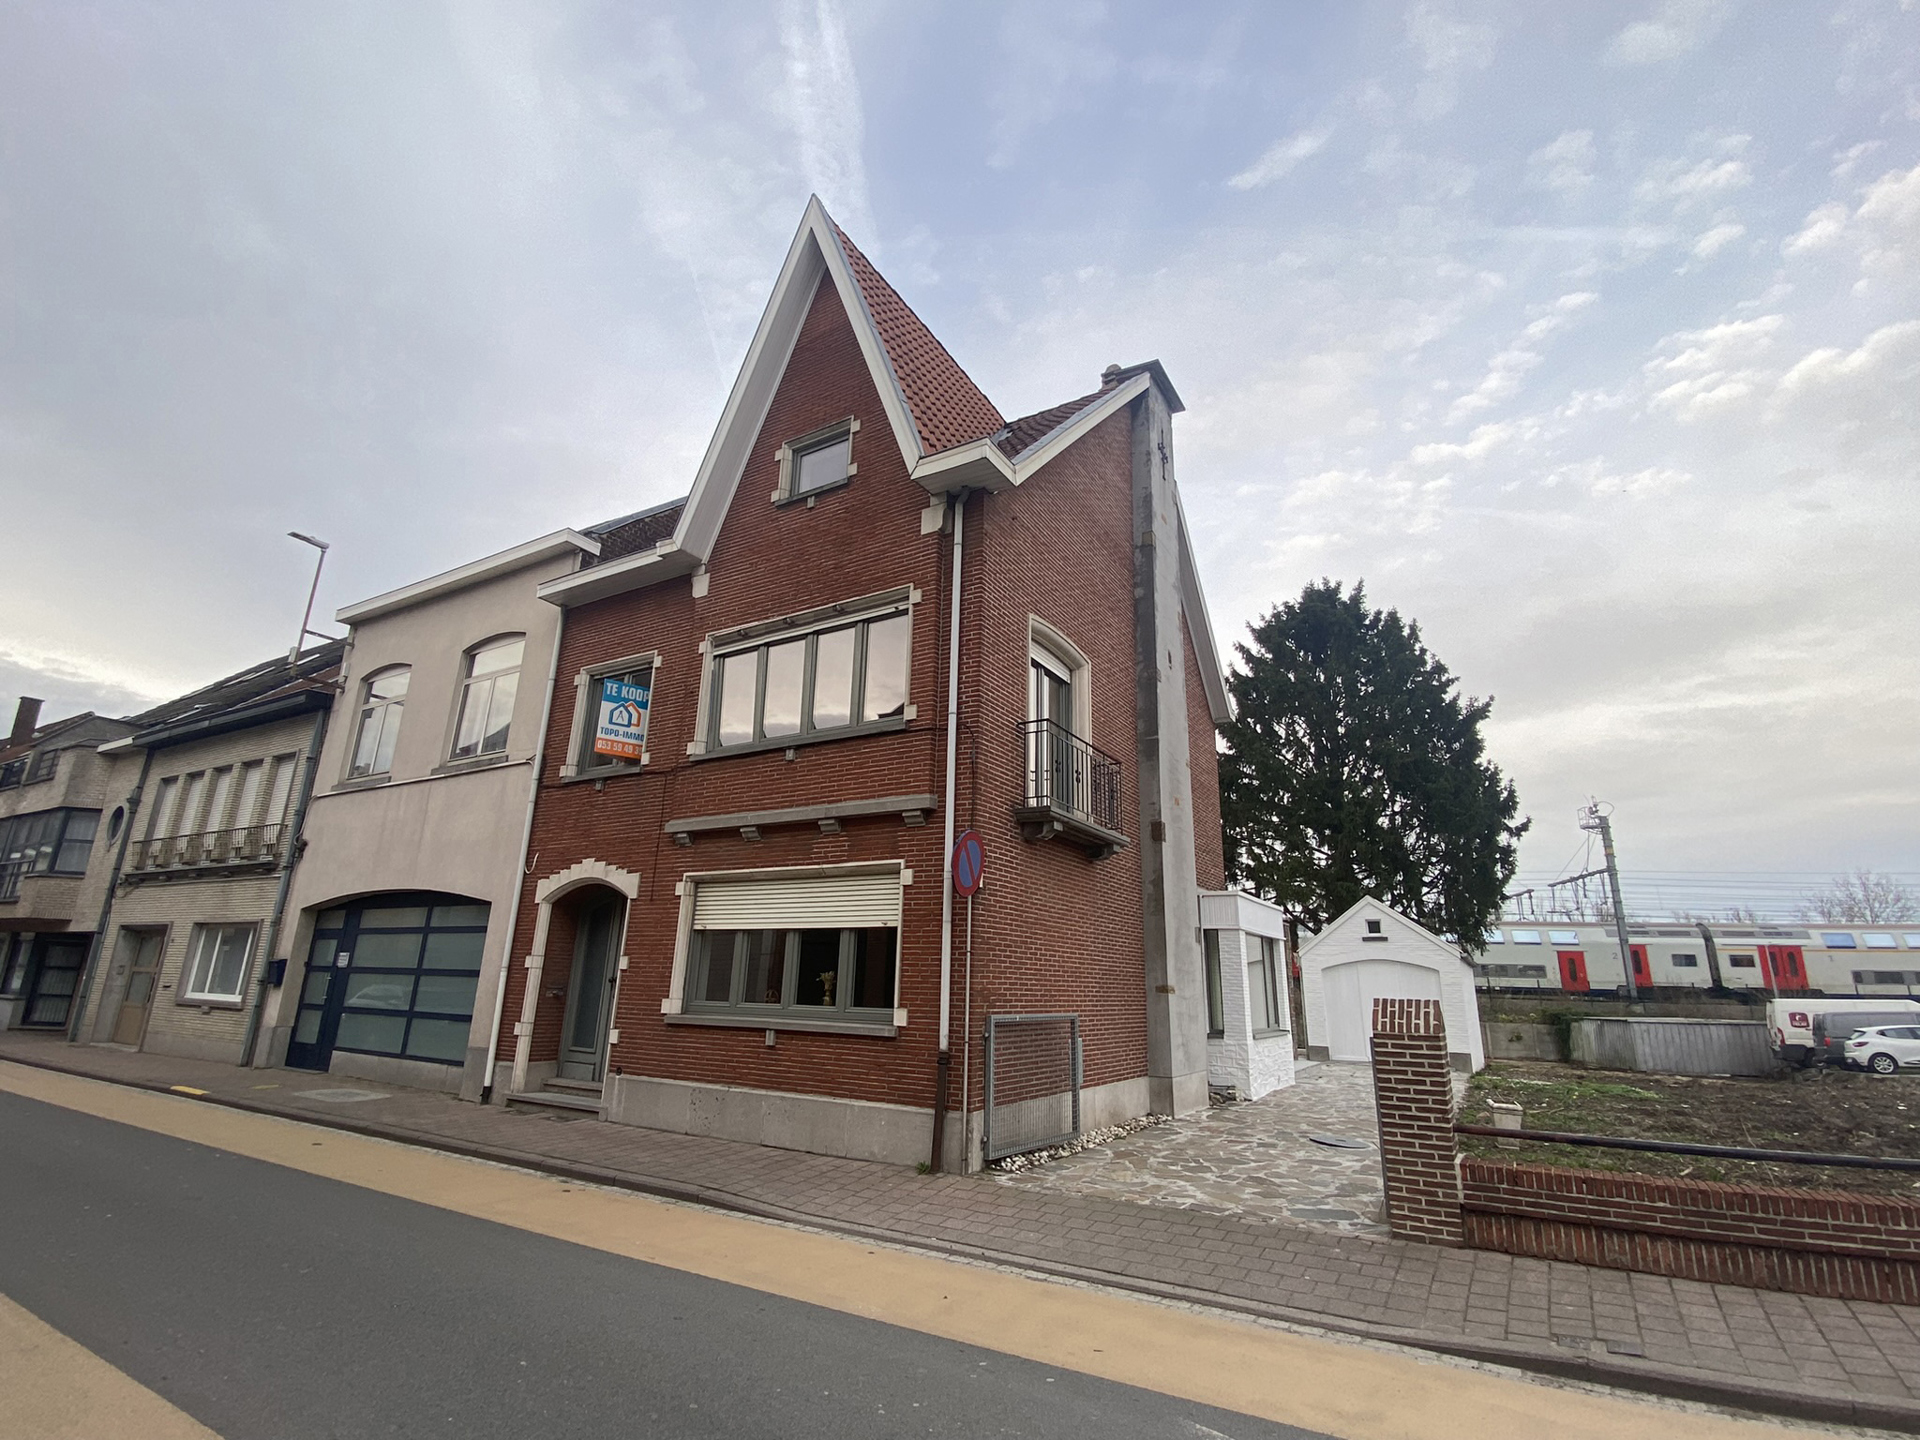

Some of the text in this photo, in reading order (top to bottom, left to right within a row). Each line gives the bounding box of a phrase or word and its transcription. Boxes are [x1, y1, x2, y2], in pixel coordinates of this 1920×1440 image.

[606, 682, 650, 702] TE KOOP
[600, 727, 645, 742] TOPO-IMMO
[597, 739, 611, 750] 053
[1612, 952, 1618, 960] 2
